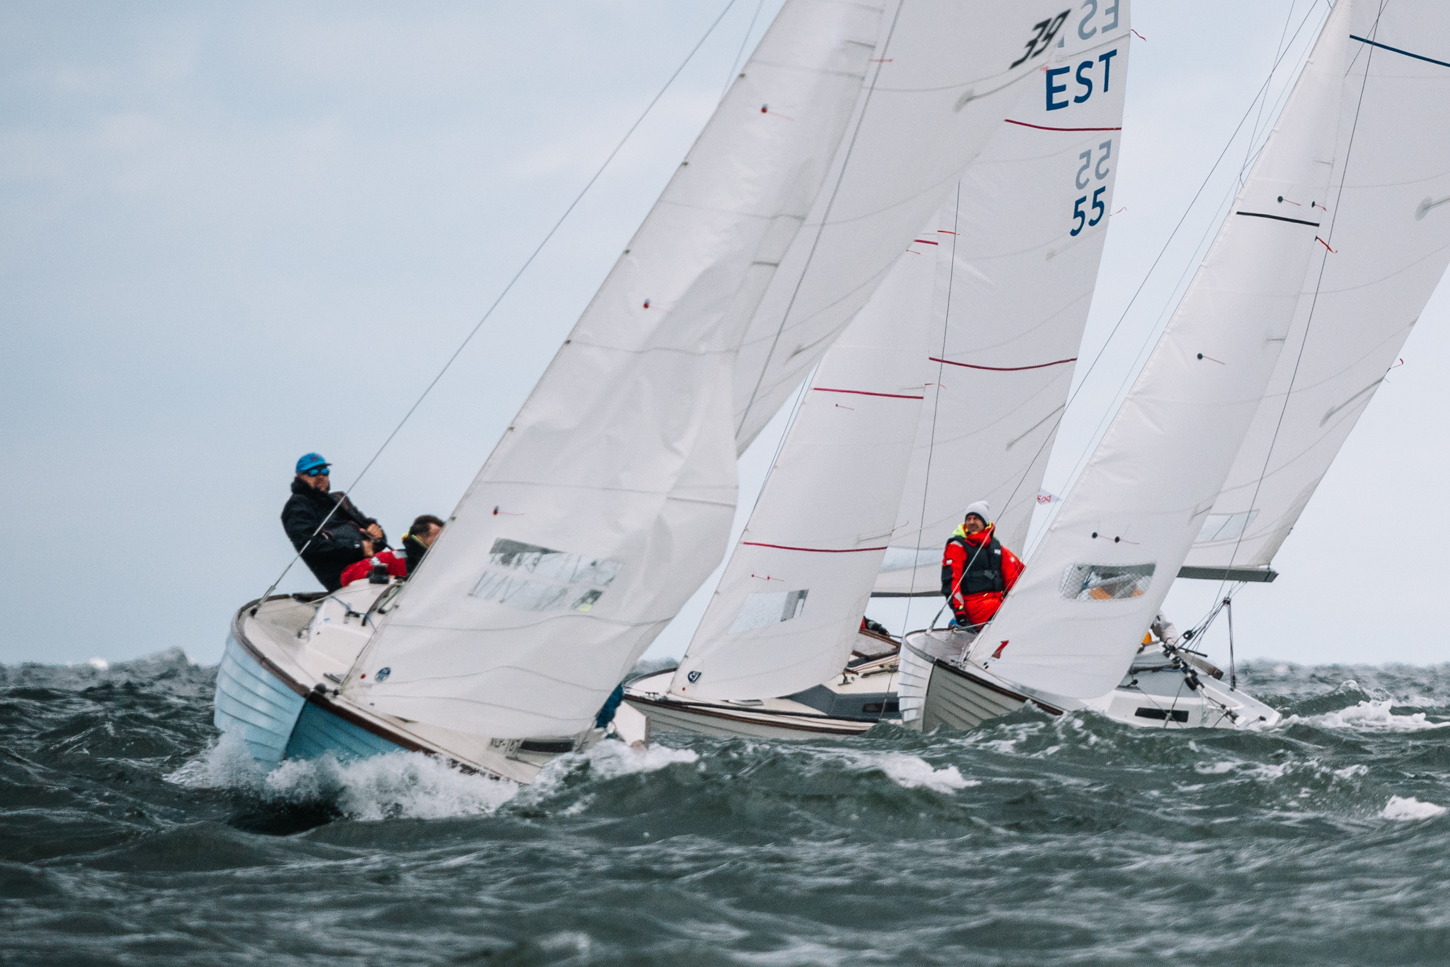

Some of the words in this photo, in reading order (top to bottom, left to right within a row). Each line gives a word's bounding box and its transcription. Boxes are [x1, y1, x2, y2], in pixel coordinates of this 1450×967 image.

[1008, 8, 1071, 70] 39
[1046, 49, 1118, 111] EST
[1069, 185, 1106, 237] 55
